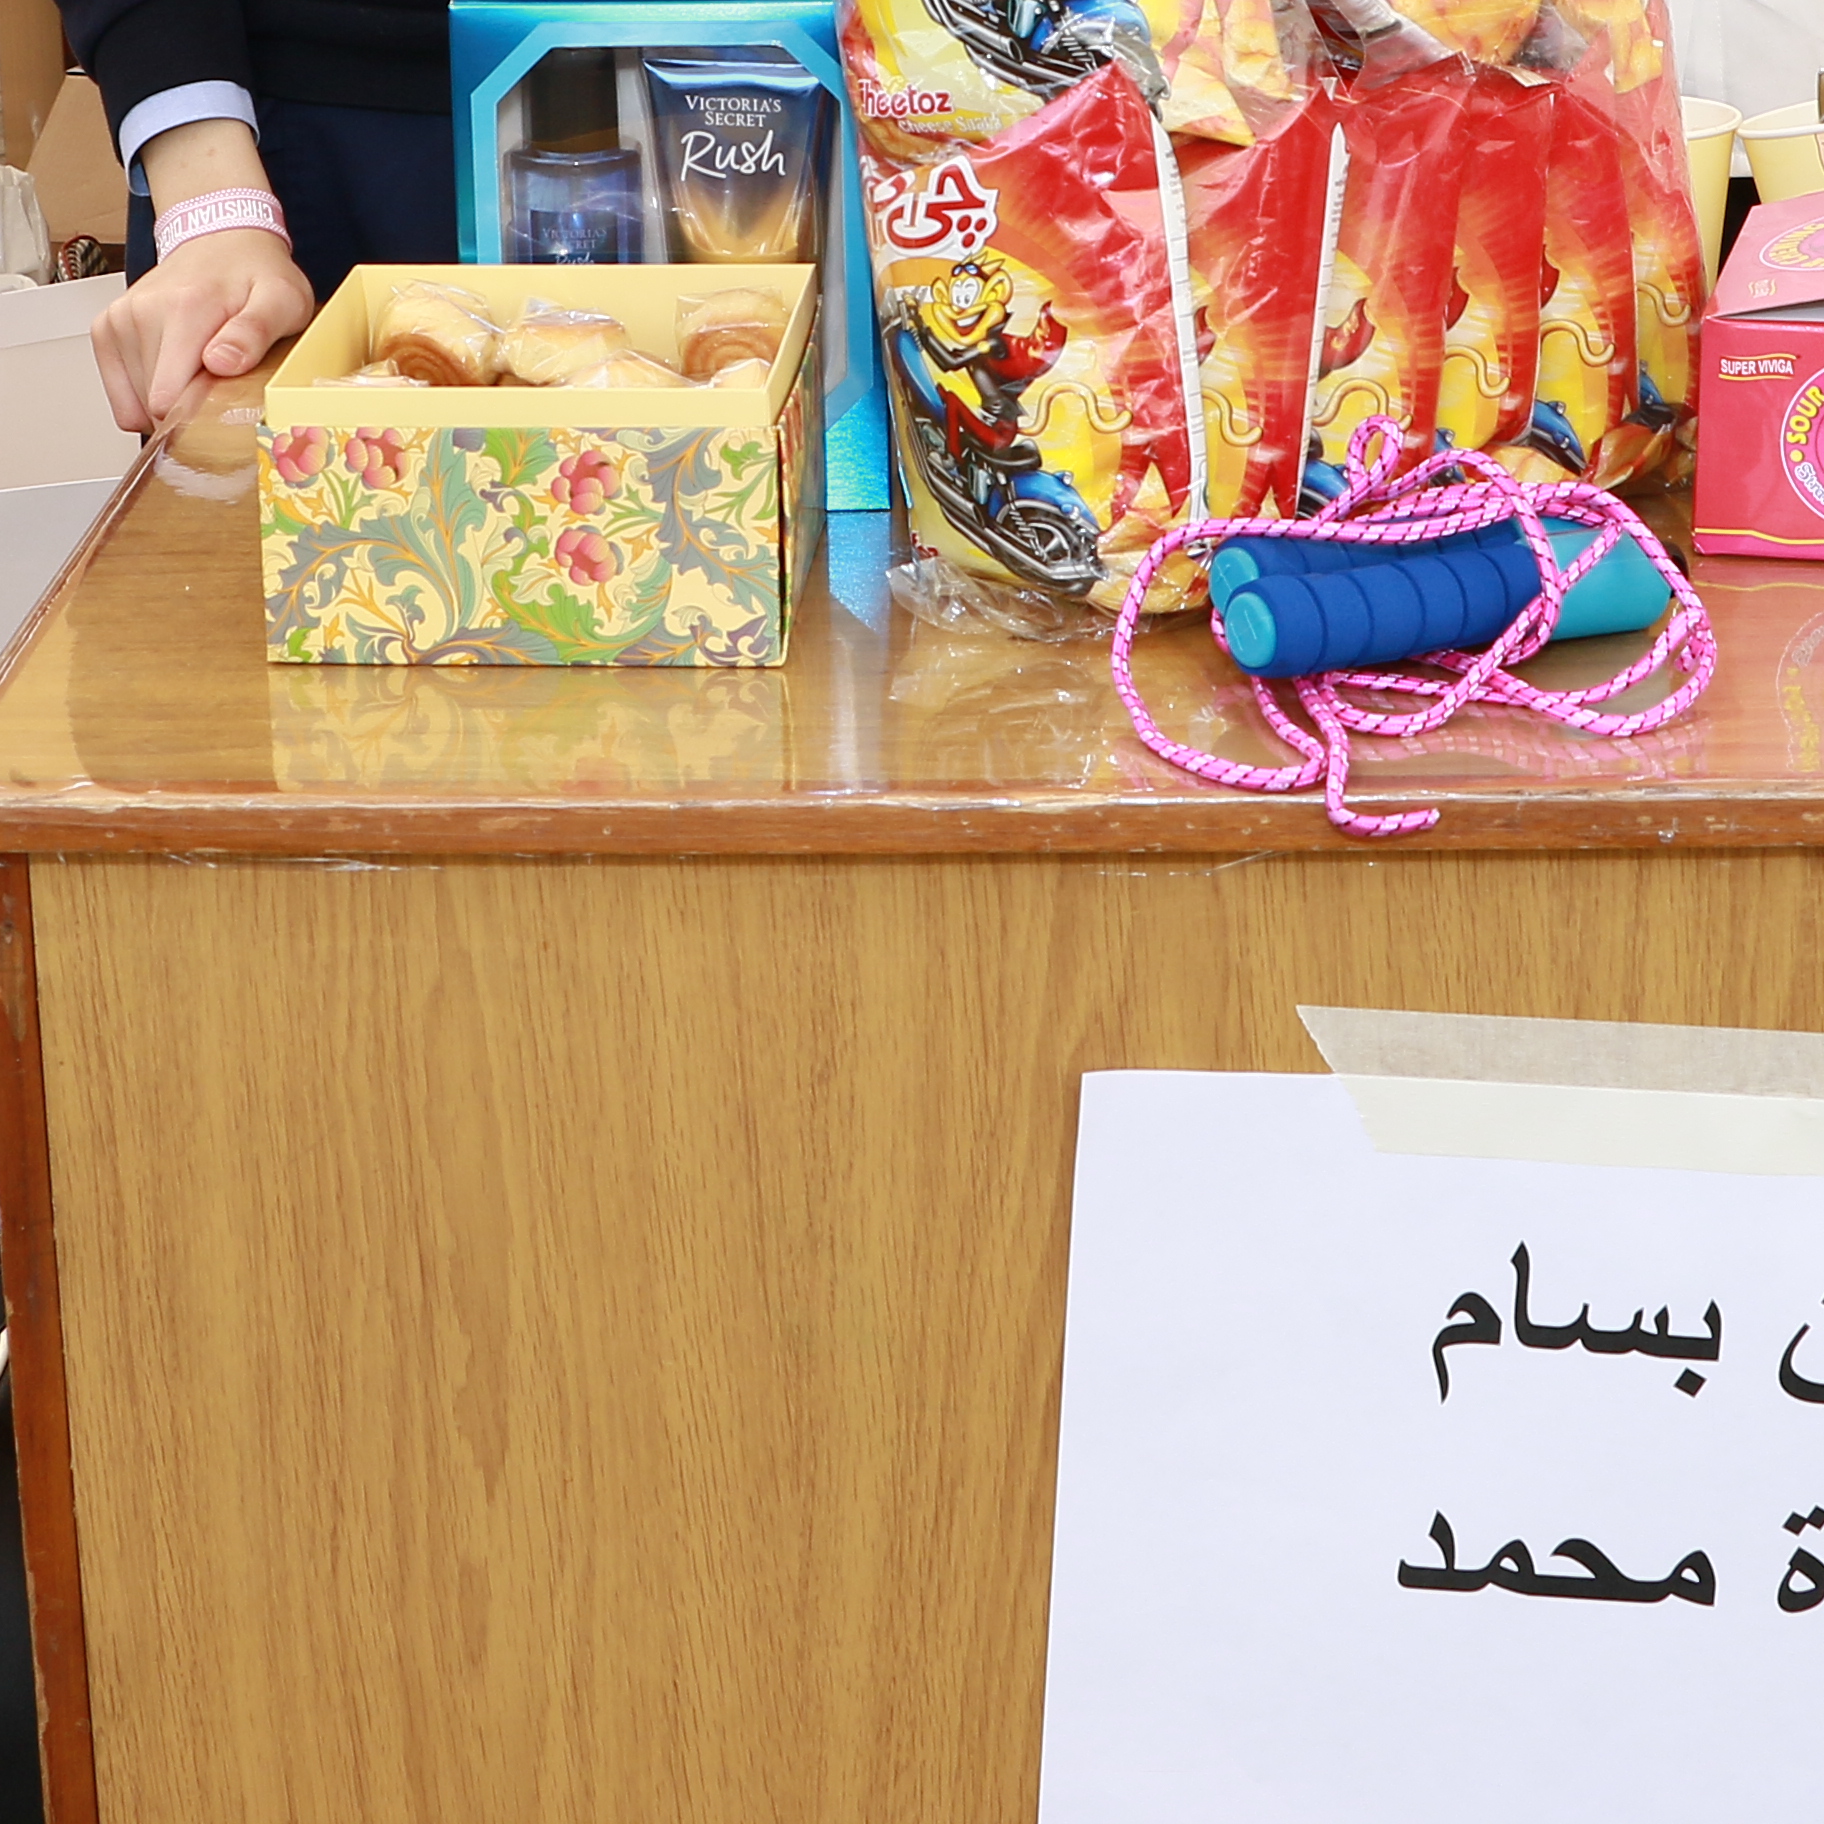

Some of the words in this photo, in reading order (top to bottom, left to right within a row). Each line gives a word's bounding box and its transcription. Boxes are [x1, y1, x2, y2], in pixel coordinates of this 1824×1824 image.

[685, 95, 782, 113] VICTORIA'S
[861, 79, 953, 118] heetoz
[704, 112, 767, 128] SECRET
[680, 129, 786, 182] Rush
[187, 199, 274, 234] CHRISTIAN
[1720, 358, 1756, 376] SUPER
[1757, 357, 1794, 375] VIVIGA
[1433, 1243, 1721, 1401] بسام
[1398, 1512, 1715, 1605] محمد
